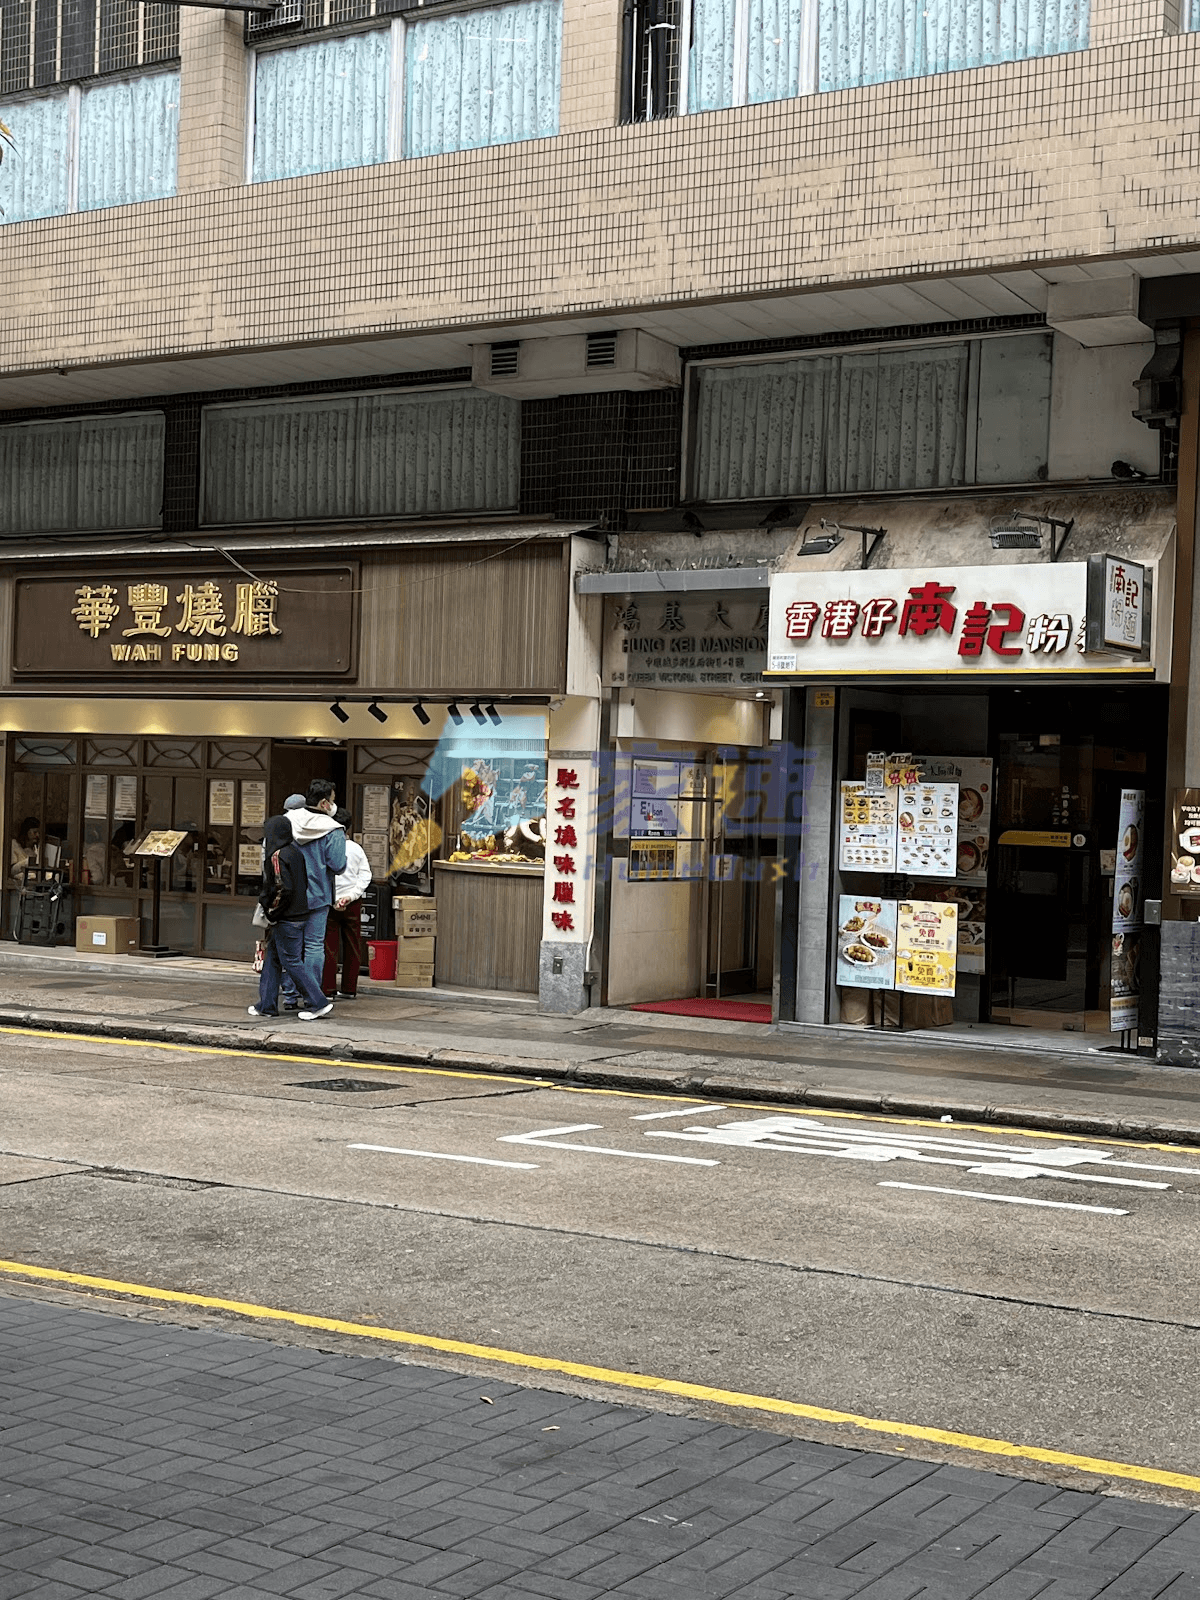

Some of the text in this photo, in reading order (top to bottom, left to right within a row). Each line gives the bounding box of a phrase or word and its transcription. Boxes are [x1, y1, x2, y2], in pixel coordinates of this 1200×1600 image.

[1115, 565, 1139, 609] 南記
[71, 581, 283, 638] 華豐燒臘
[786, 582, 1086, 656] 香港仔南記粉
[110, 643, 239, 662] WAH FUNG
[622, 636, 768, 652] HUNG KEI MANSION
[627, 672, 656, 683] QUEEN
[659, 672, 698, 683] VICTORIA
